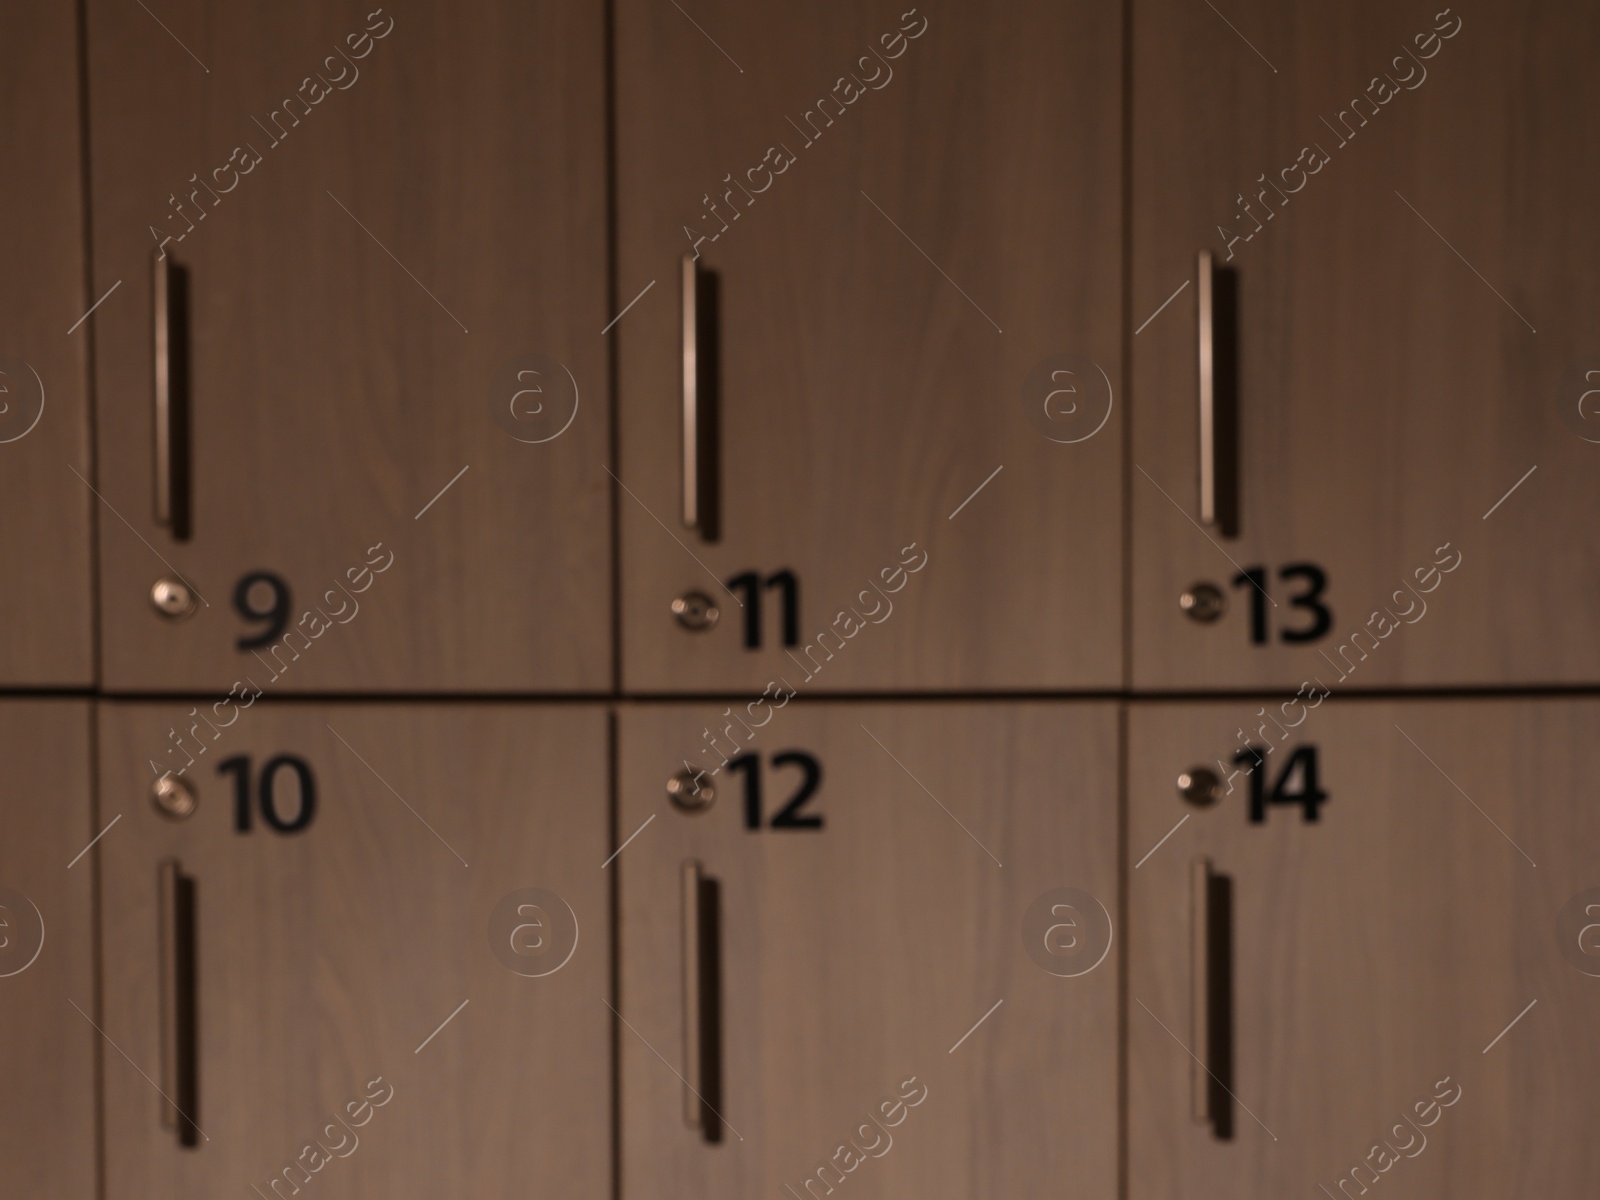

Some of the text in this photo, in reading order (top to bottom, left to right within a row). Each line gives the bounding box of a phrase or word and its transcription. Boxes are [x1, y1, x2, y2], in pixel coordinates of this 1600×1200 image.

[233, 569, 292, 653] 9
[726, 566, 800, 651] 11
[1231, 563, 1333, 647] 13
[215, 753, 317, 835] 10
[725, 751, 825, 831] 12
[1231, 745, 1330, 824] 14
